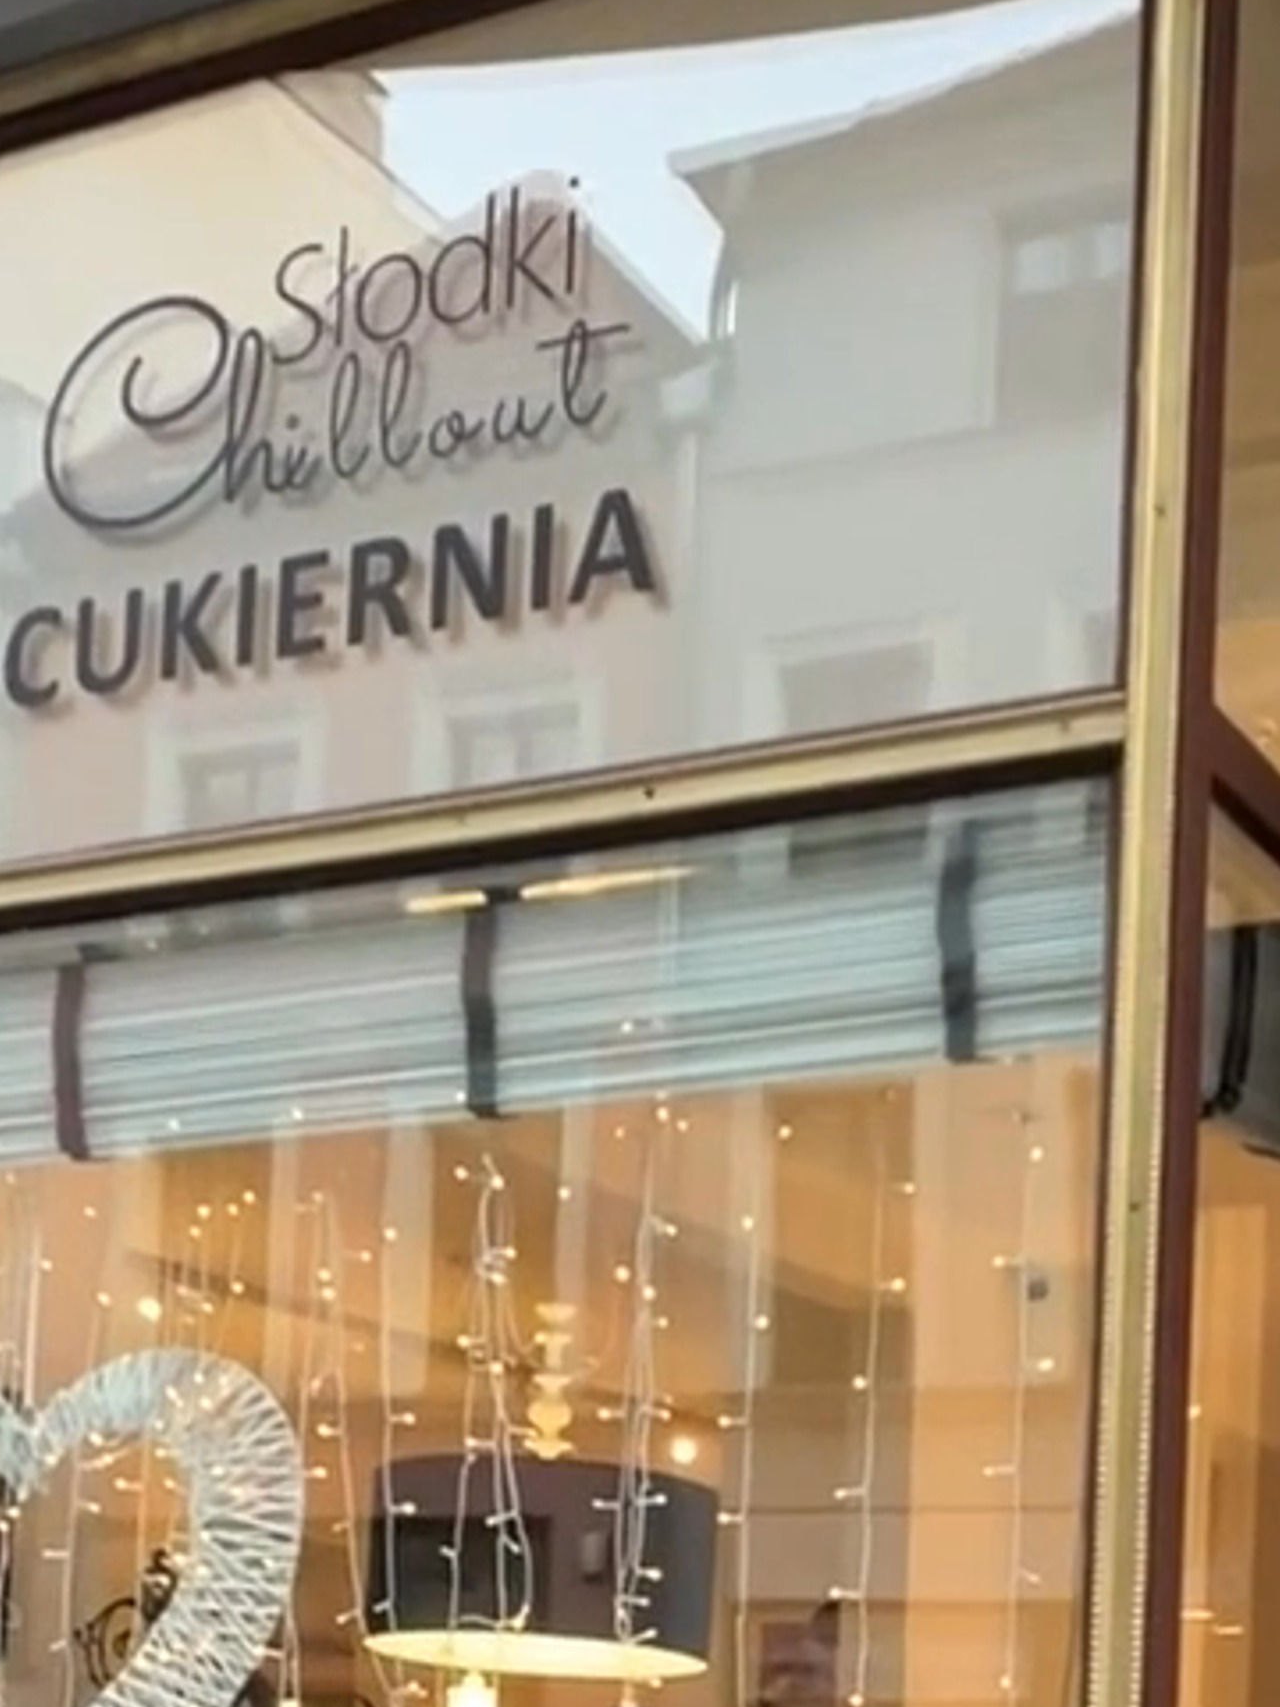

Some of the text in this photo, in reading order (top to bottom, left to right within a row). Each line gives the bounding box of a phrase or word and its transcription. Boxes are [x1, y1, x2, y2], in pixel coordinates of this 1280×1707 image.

[274, 175, 581, 365] Słodki
[44, 297, 632, 529] Chillout
[3, 488, 654, 708] CUKIERNIA
